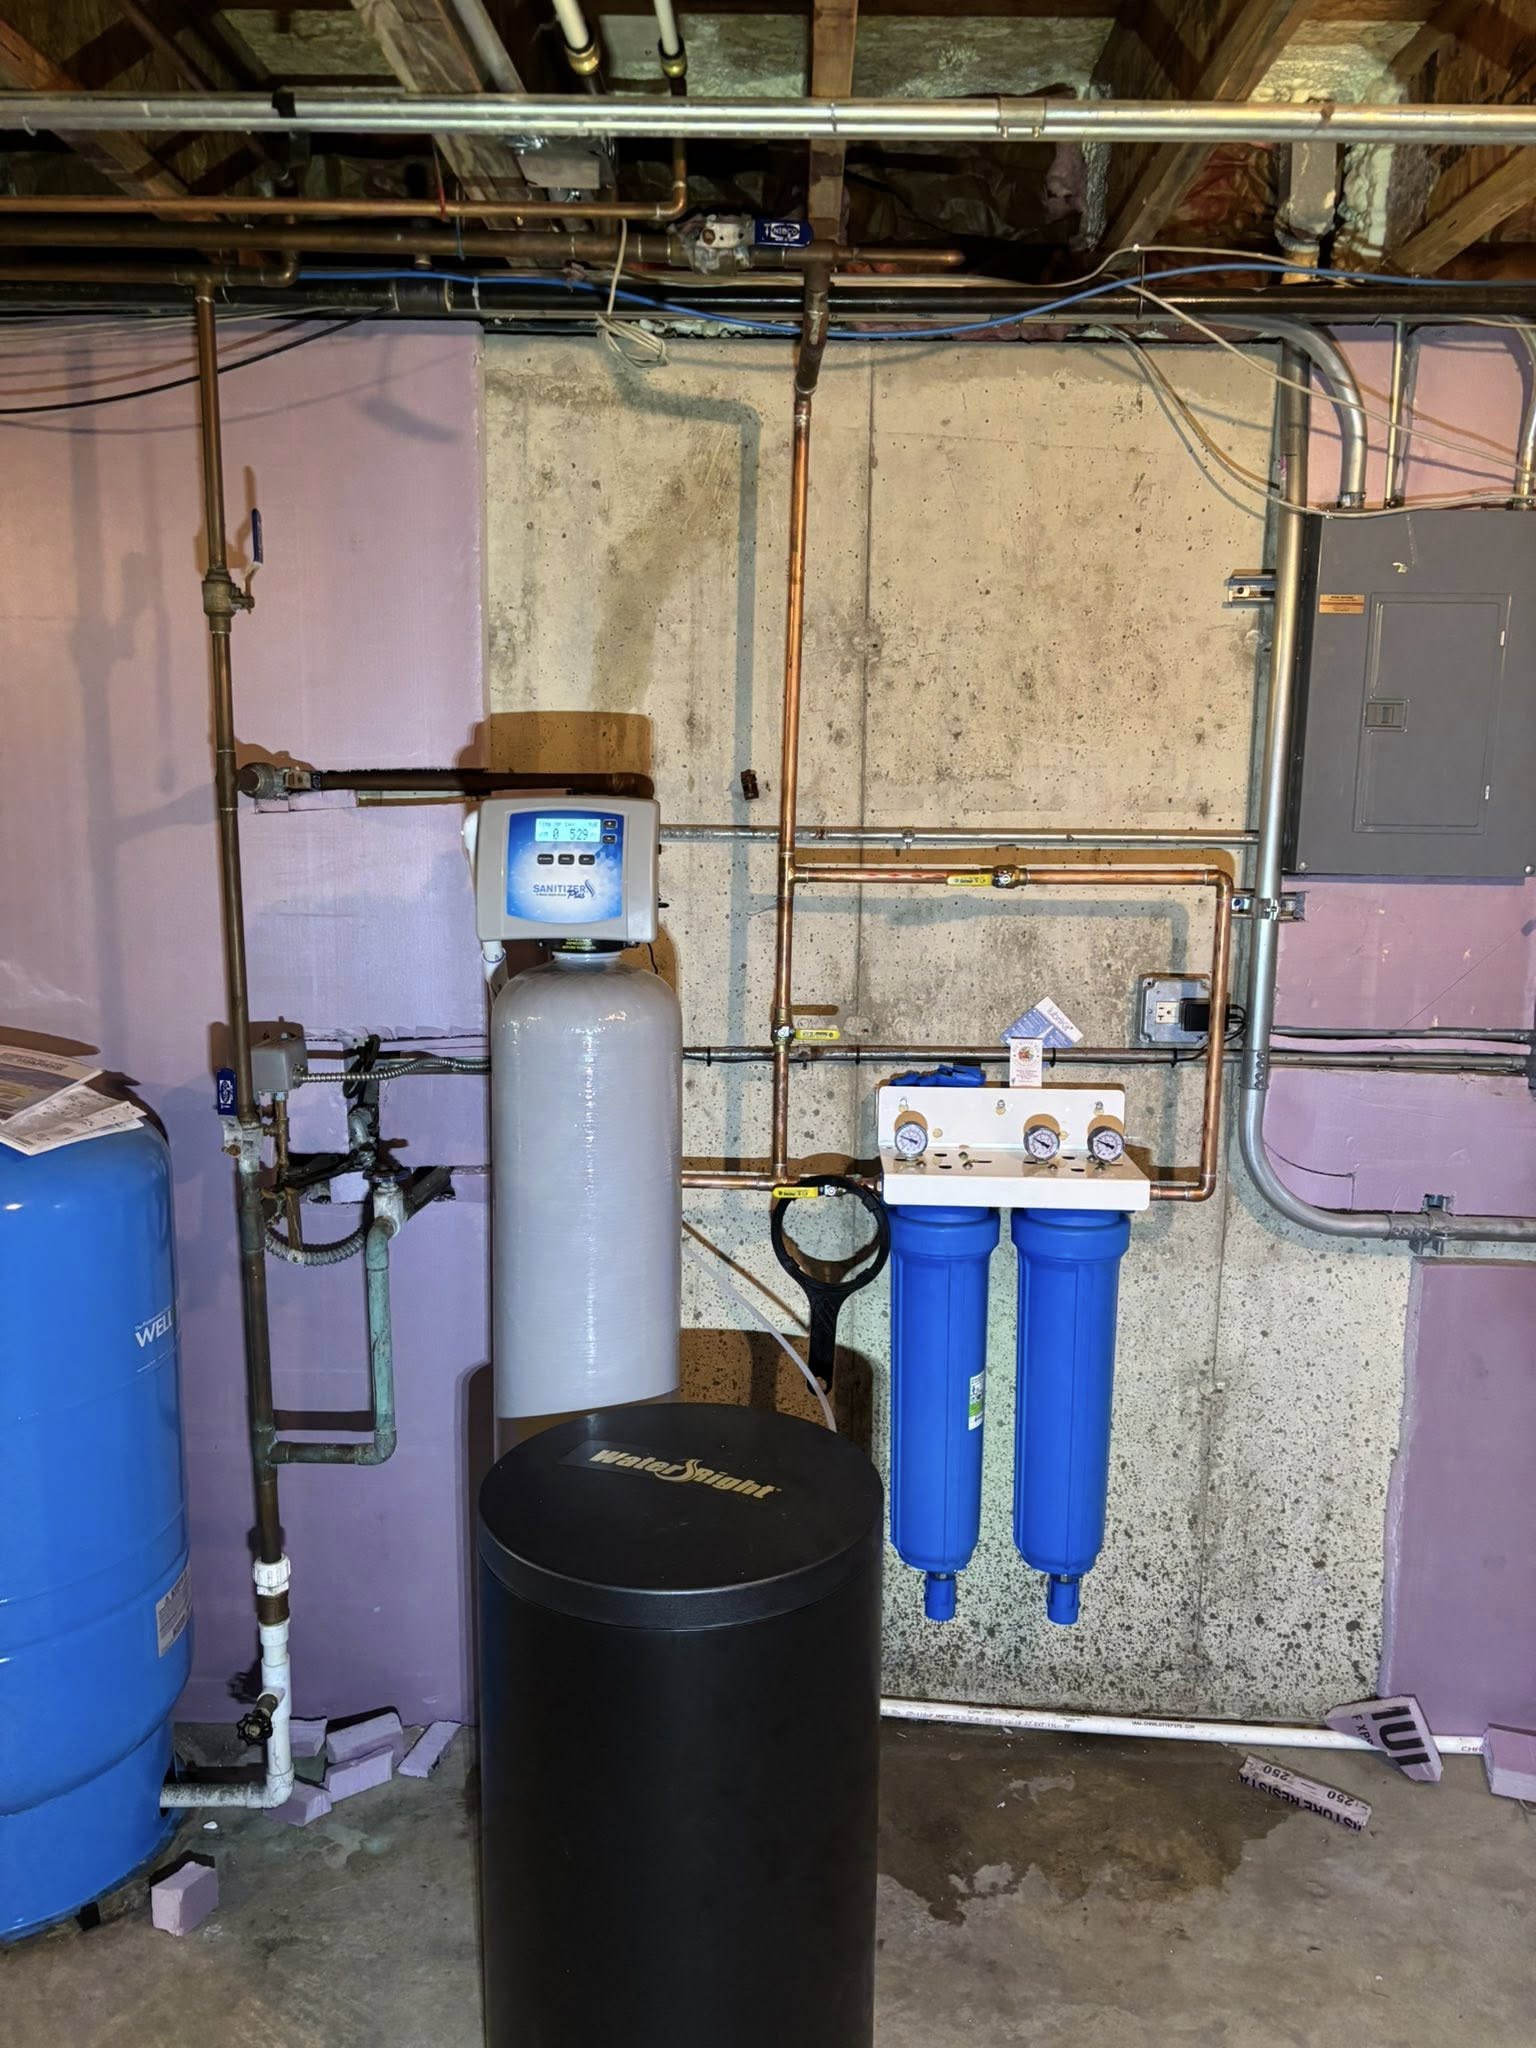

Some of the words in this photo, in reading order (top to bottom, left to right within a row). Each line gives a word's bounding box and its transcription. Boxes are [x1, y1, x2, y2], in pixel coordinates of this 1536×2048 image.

[773, 226, 798, 237] NIBCO
[533, 884, 586, 893] SANITIZER
[1263, 1764, 1291, 1781] 250
[1327, 1790, 1355, 1807] 250
